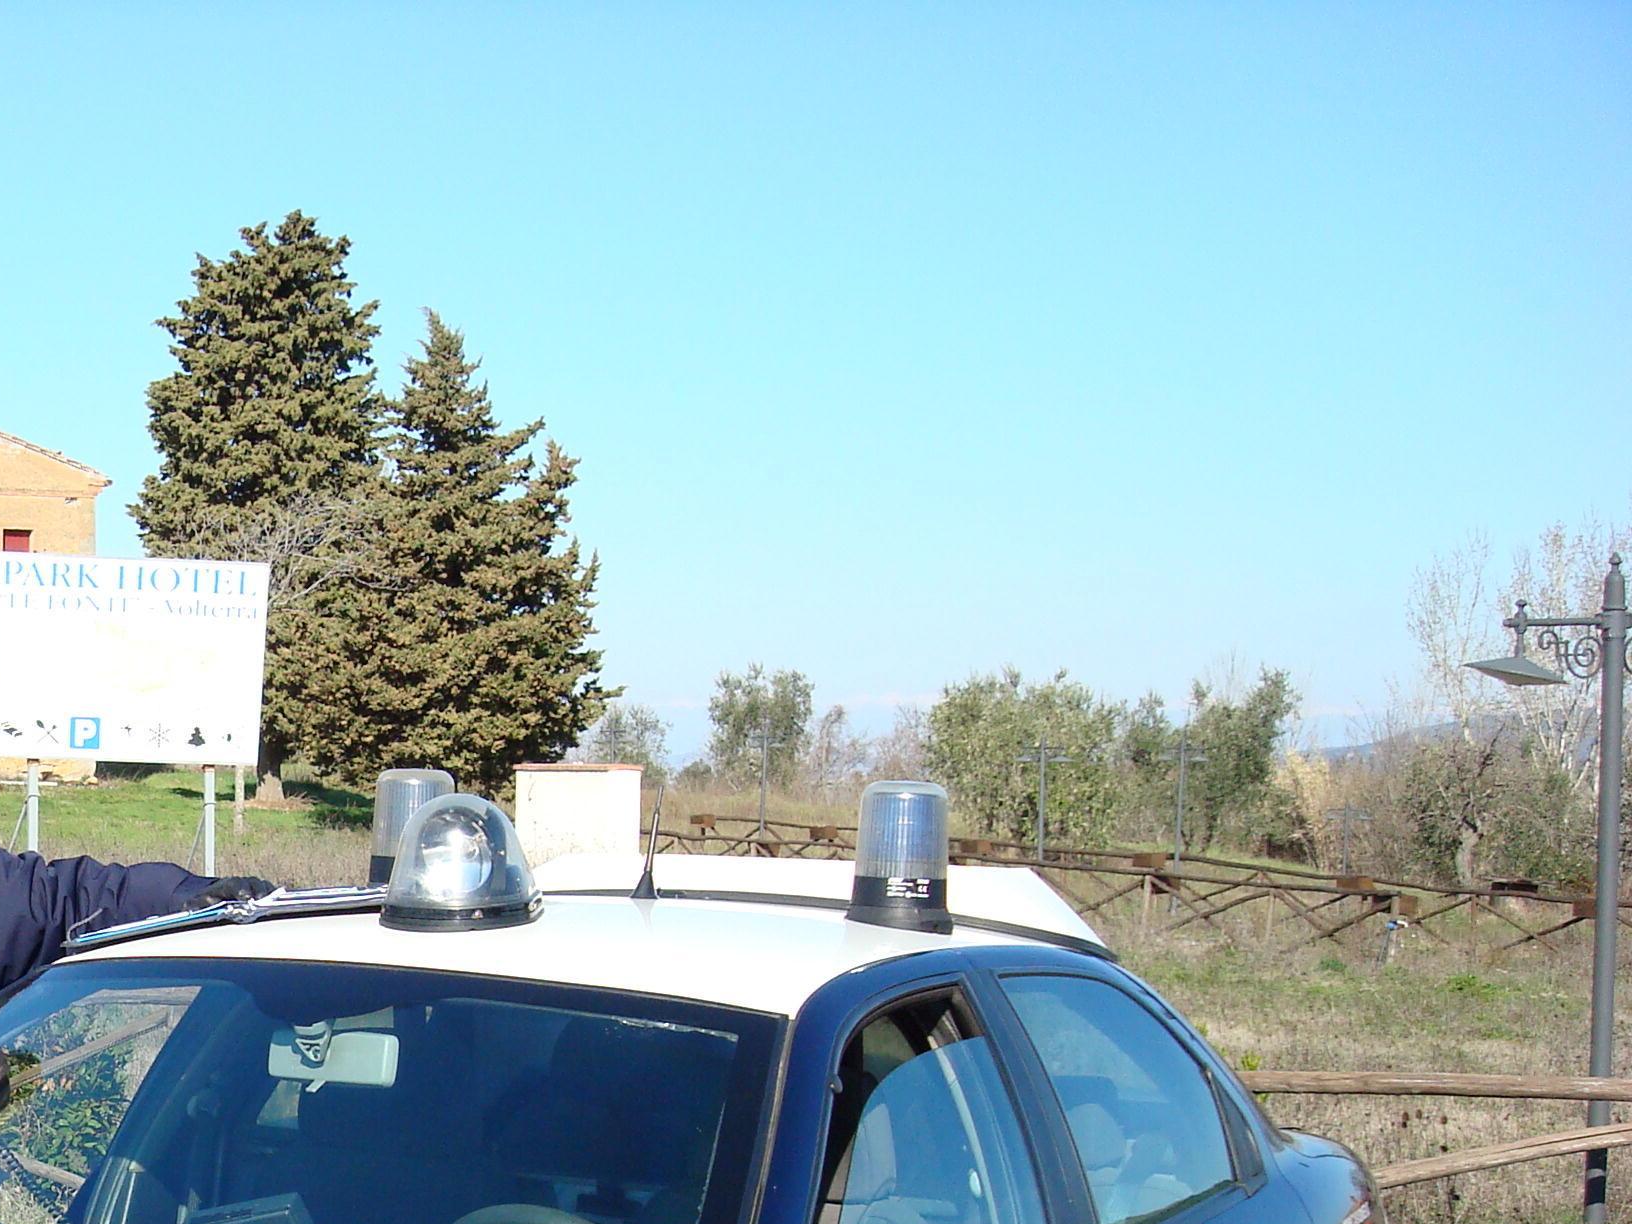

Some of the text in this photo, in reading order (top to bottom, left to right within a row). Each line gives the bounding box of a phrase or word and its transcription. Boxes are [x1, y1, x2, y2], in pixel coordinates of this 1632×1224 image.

[2, 560, 257, 597] PARK HOTEL
[74, 718, 98, 747] P
